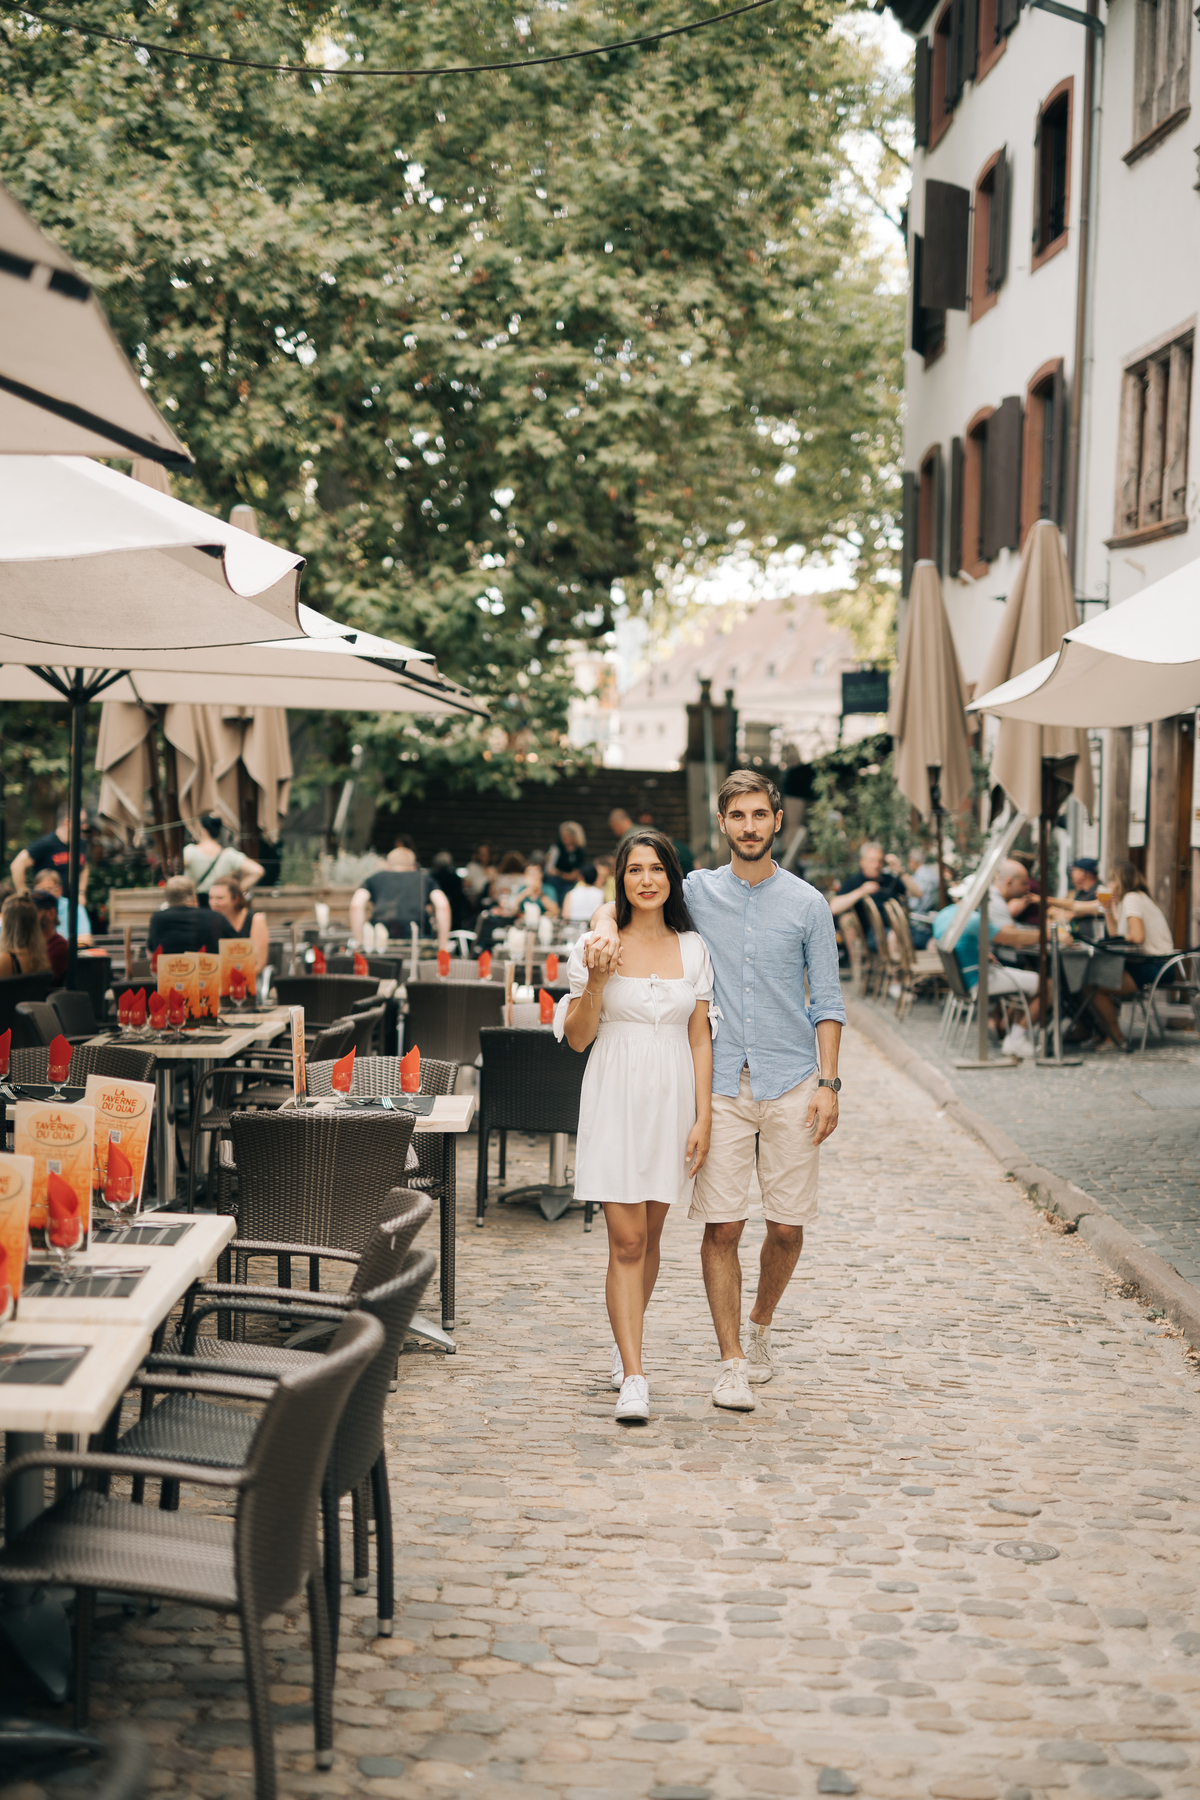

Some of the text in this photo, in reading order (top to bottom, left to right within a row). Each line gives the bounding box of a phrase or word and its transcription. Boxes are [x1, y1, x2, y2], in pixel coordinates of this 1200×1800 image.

[115, 1089, 125, 1097] LA
[102, 1094, 138, 1106] TAVERNE
[102, 1102, 136, 1114] DU QUAI
[49, 1114, 61, 1122] LA
[35, 1122, 77, 1132] TAVERNE
[36, 1130, 75, 1141] DU QUAI
